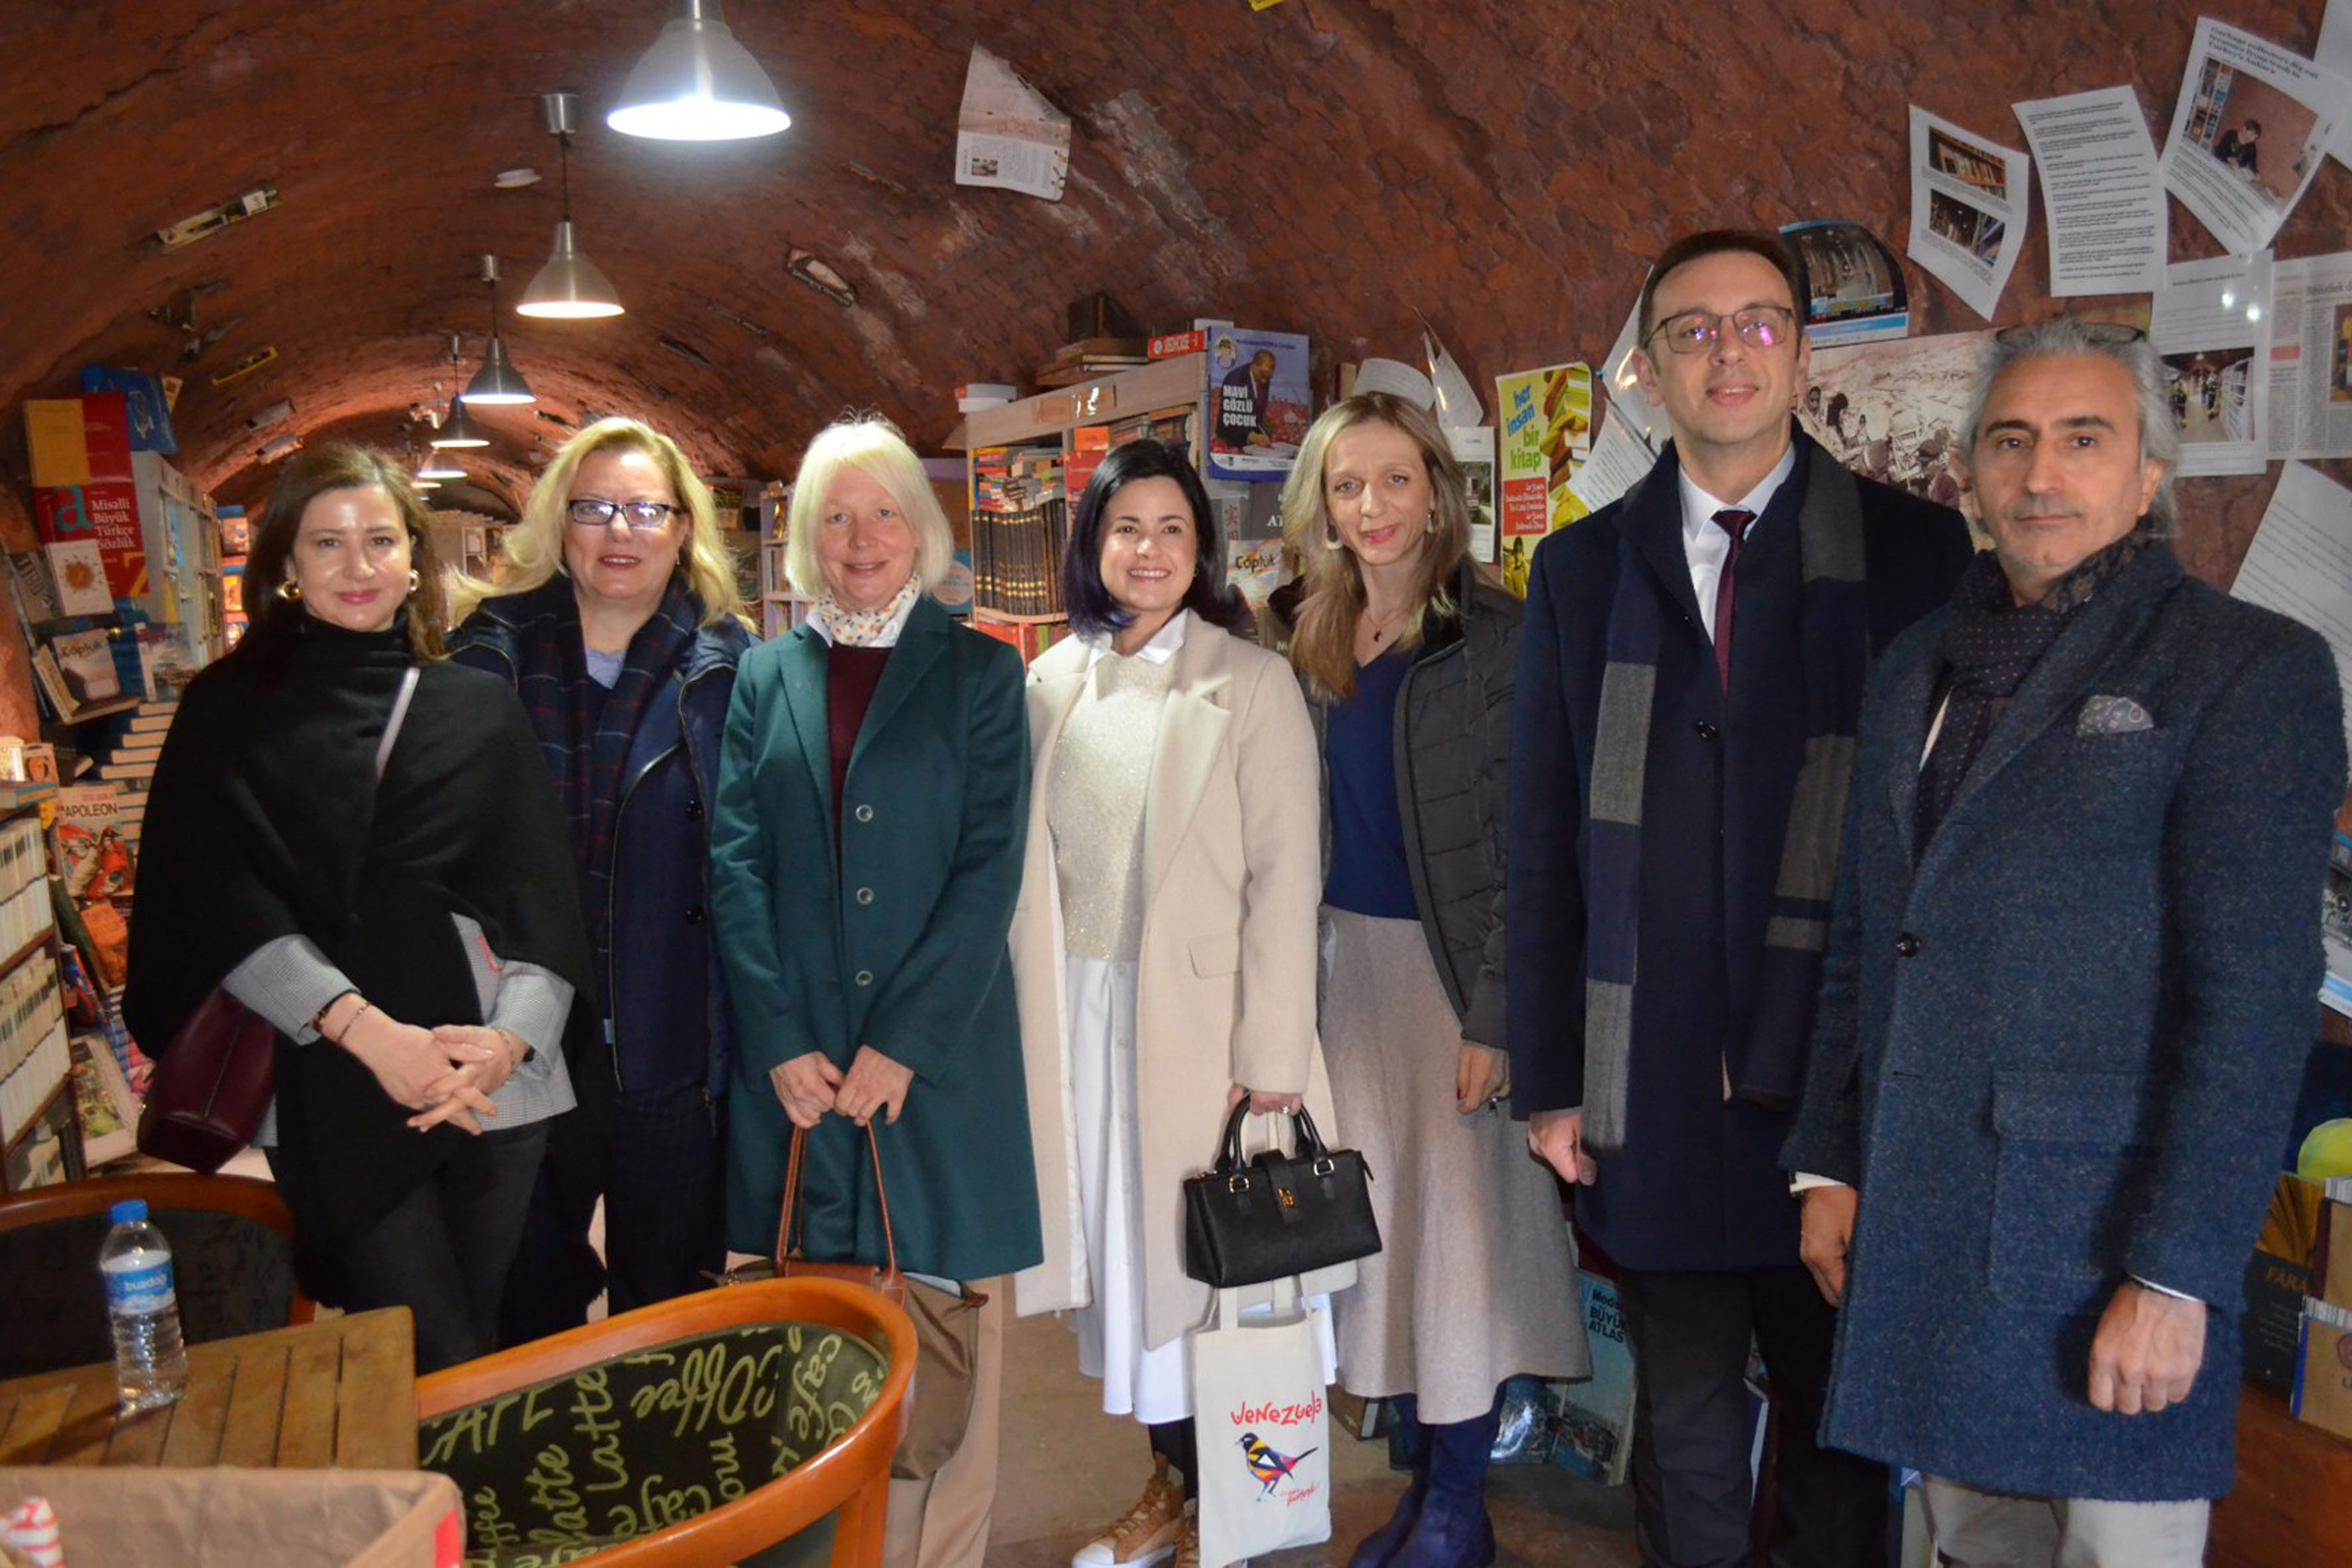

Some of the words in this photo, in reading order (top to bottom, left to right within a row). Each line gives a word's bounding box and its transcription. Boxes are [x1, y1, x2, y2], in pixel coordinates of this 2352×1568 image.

[1223, 385, 1248, 398] MAVİ
[1514, 384, 1531, 410] her
[1223, 399, 1253, 414] GÖZLÜ
[1223, 413, 1257, 428] ÇOCUK
[1506, 404, 1536, 437] insan
[1523, 425, 1540, 447] bir
[1510, 447, 1542, 473] kitap
[92, 497, 130, 510] Misalli
[93, 510, 131, 526] Büyük
[95, 524, 135, 538] Türkçe
[98, 536, 136, 550] Sözlük
[1589, 1320, 1624, 1344] ATLAS
